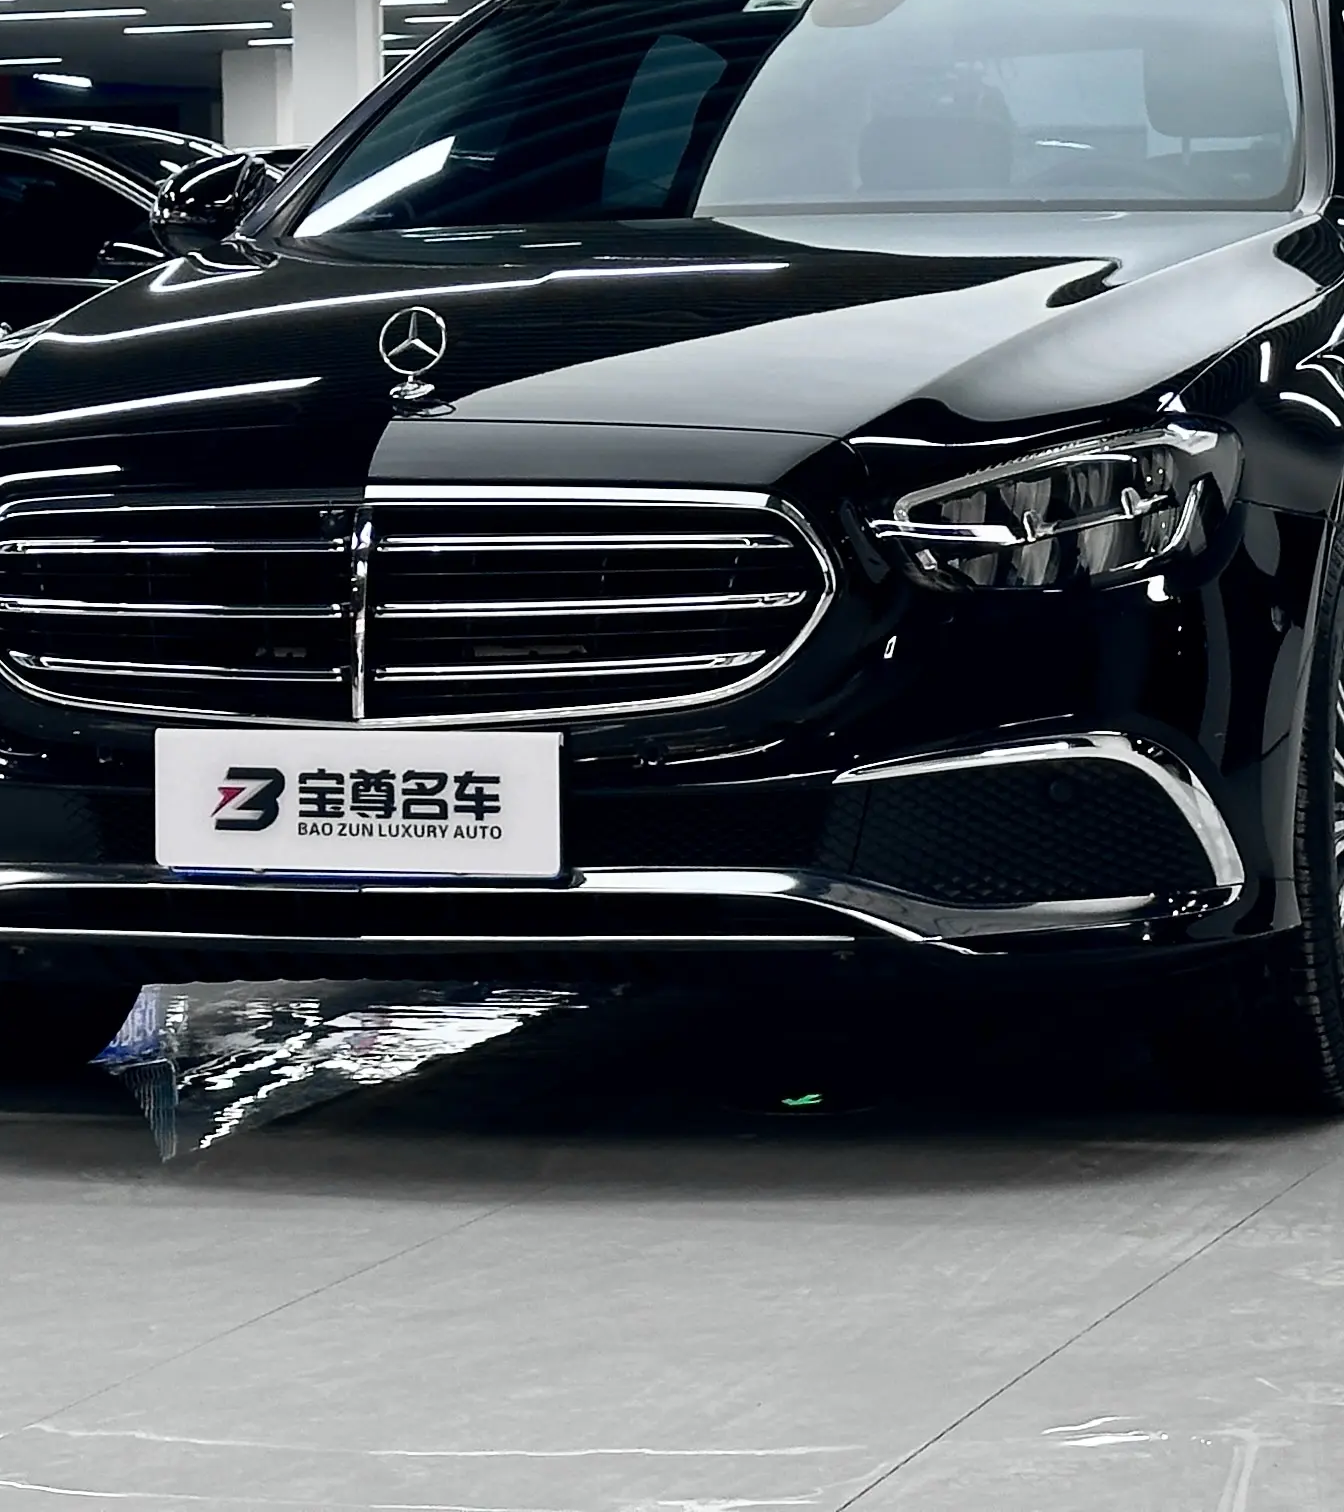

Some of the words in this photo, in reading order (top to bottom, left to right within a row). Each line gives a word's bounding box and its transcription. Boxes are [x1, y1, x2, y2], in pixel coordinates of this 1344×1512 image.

[298, 768, 502, 821] 宝尊名车
[297, 822, 333, 837] BAO
[337, 822, 374, 837] ZUN
[378, 823, 449, 839] LUXURY
[453, 824, 502, 839] AUTO
